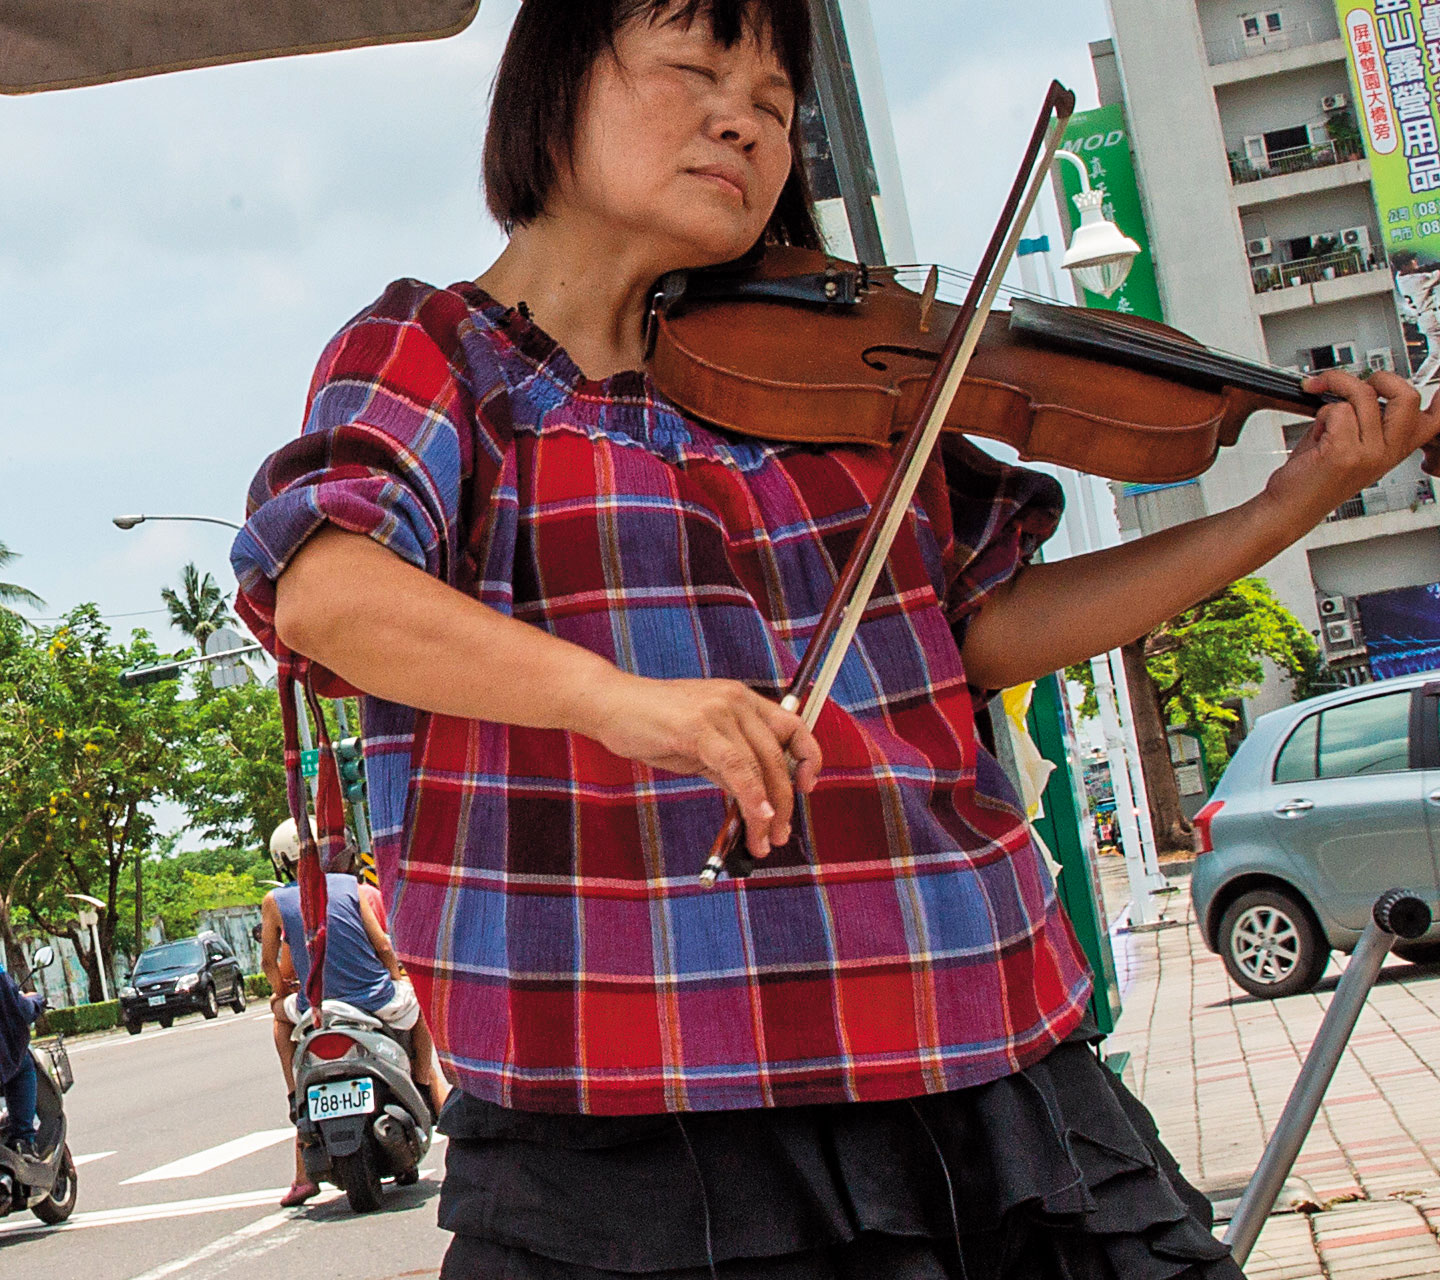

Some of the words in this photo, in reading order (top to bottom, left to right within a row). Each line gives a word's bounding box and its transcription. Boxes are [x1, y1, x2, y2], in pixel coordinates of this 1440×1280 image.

[1352, 23, 1392, 142] 屏東雙園大橋旁
[1387, 206, 1411, 223] 公司
[310, 1089, 371, 1115] 788-HJP
